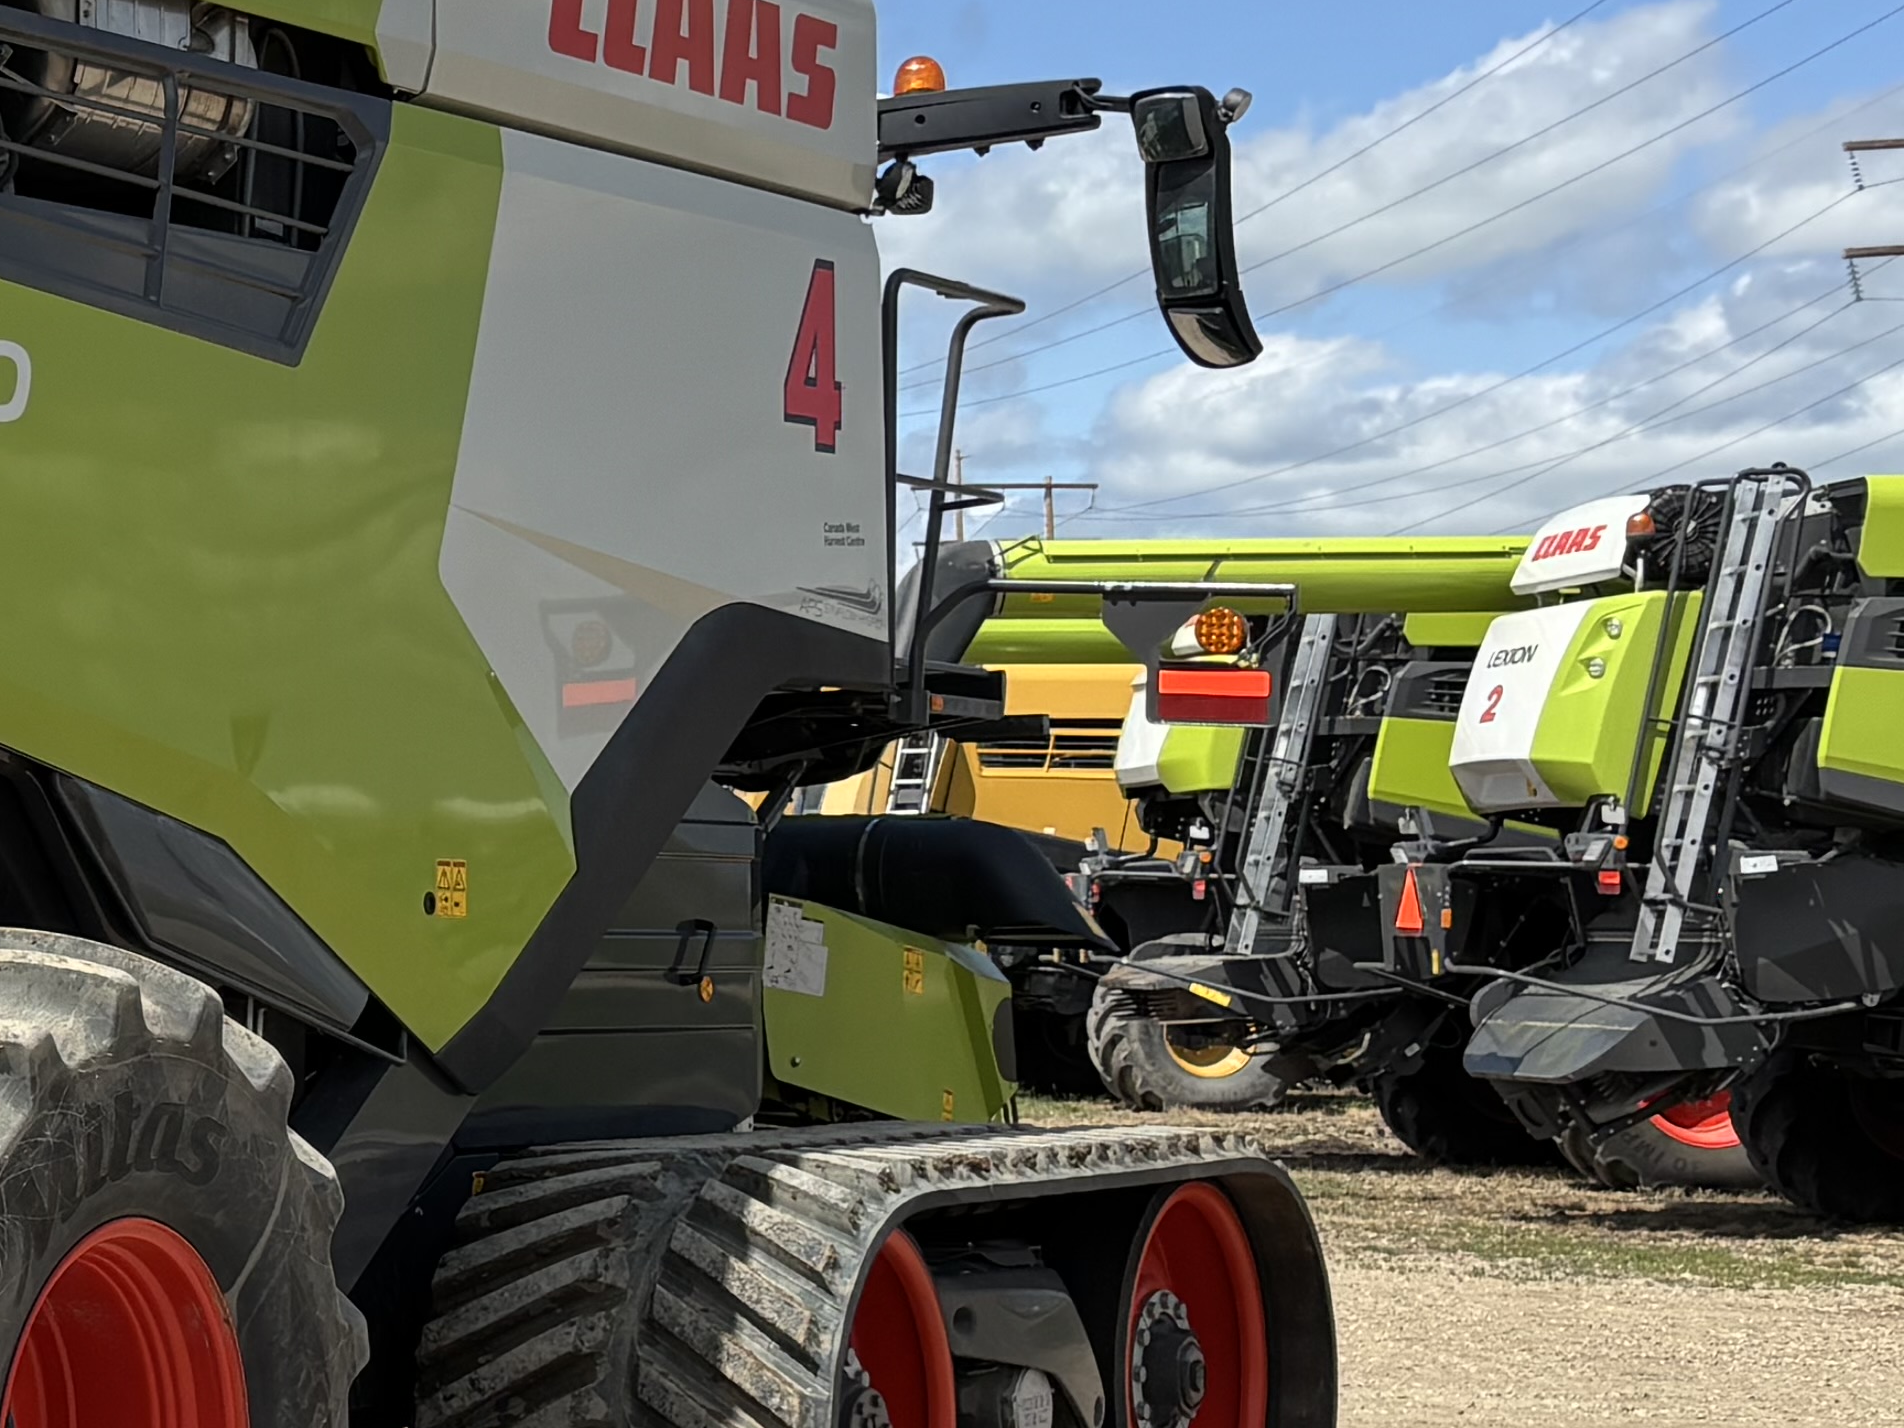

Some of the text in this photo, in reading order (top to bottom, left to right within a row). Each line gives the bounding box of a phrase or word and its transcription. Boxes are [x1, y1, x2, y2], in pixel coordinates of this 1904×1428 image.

[782, 258, 844, 454] 4
[1531, 524, 1608, 562] CLAAS
[1486, 643, 1539, 669] LEXION
[1479, 684, 1504, 724] 2
